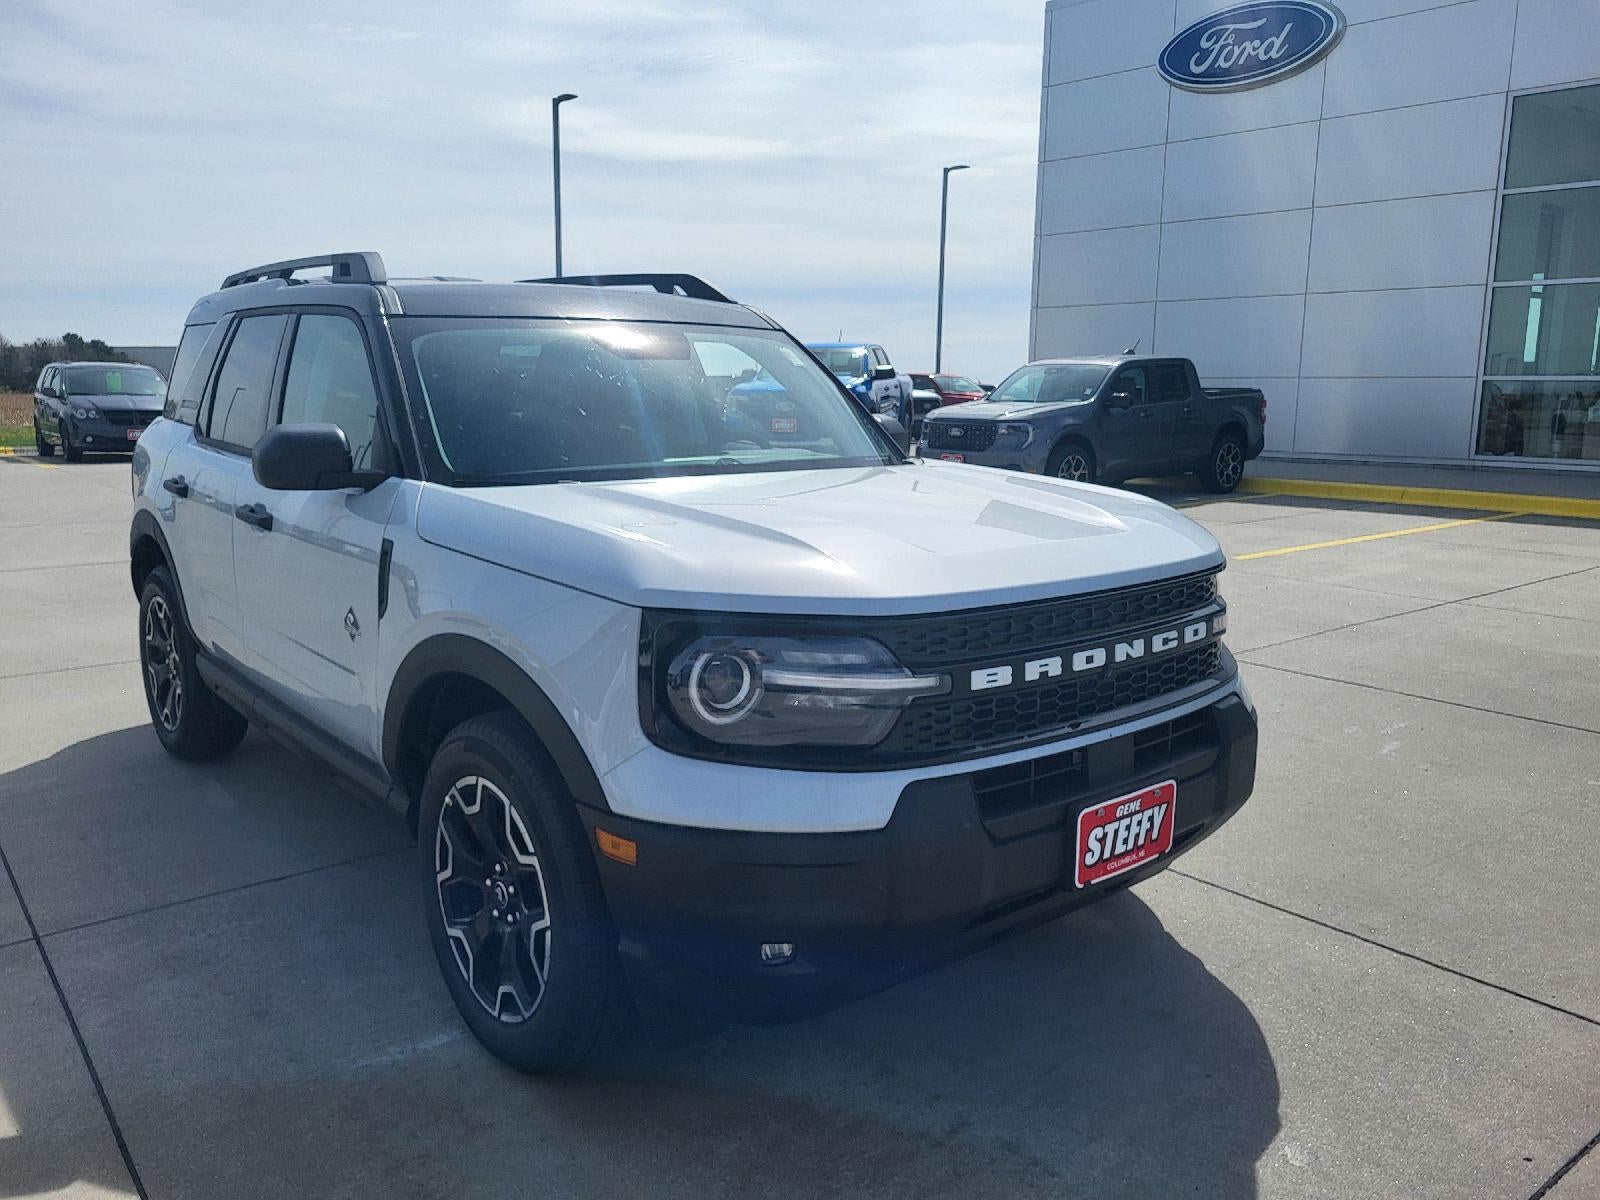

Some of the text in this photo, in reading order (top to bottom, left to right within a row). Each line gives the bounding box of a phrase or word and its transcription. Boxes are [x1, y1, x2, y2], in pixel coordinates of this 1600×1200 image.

[1190, 18, 1293, 74] Ford
[971, 622, 1207, 691] BRONCO
[1085, 803, 1168, 866] STEFFY
[1116, 799, 1142, 818] GENE
